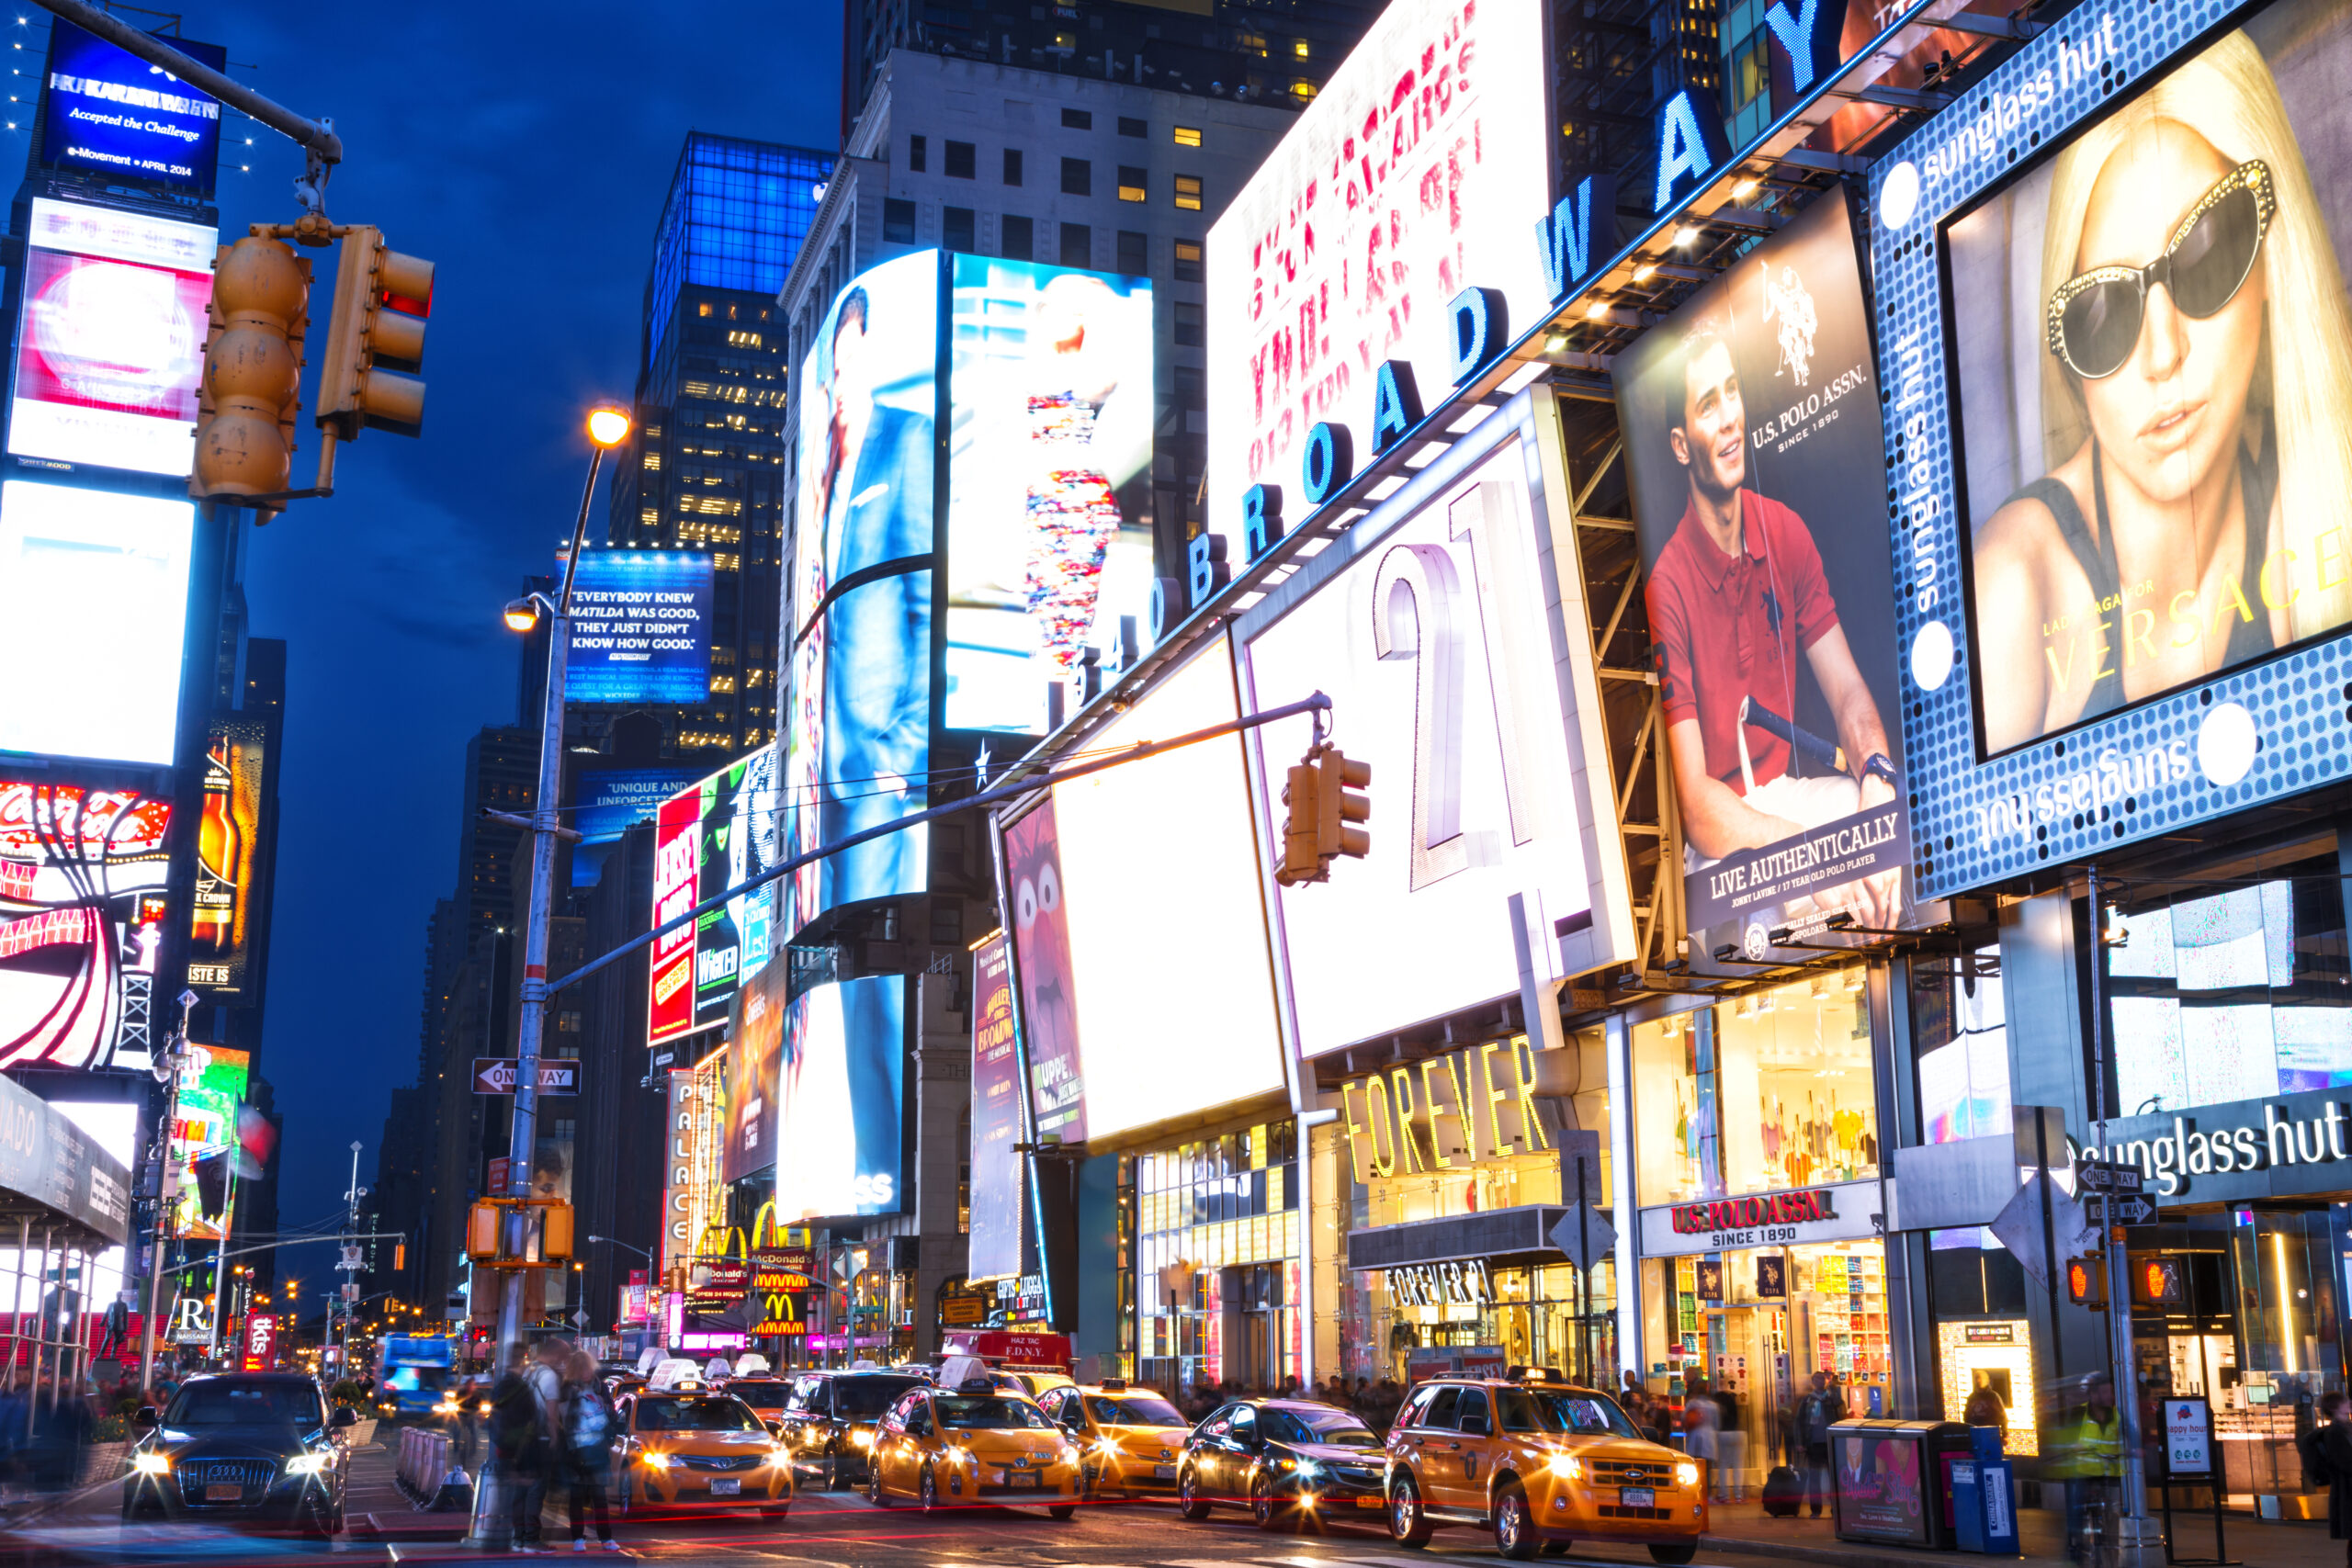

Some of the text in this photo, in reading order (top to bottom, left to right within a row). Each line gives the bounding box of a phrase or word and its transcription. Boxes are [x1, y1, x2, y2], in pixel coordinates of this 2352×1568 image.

[1925, 13, 2119, 186] sunglass hut
[69, 107, 199, 142] Accepted the Challenge
[141, 160, 168, 173] APRIL
[170, 164, 192, 176] 2014
[1752, 365, 1867, 449] U.S. POLO ASSN.
[1778, 410, 1839, 454] SINCE 1890
[1894, 324, 1940, 614] sunglass hut
[655, 592, 695, 604] KNEW
[2045, 525, 2349, 695] VERSACE
[2127, 580, 2154, 605] FOR
[569, 607, 700, 621] MATILDA WAS GOOD,
[575, 622, 609, 633] THEY
[611, 623, 643, 634] JUST
[572, 637, 615, 649] KNOW
[617, 638, 650, 649] HOW
[597, 795, 669, 806] UNFORGETT
[662, 782, 688, 792] AND
[1978, 739, 2191, 852] sunglass hut
[655, 821, 699, 905] JERSEY
[1710, 812, 1898, 899] LIVE AUTHENTICALLY
[1731, 895, 1752, 908] JONNY
[1753, 886, 1776, 901] LAVINE
[1783, 881, 1791, 892] 17
[1791, 874, 1810, 889] YEAR
[1811, 871, 1826, 882] OLD
[1826, 865, 1846, 878] POLO
[1847, 853, 1875, 872] PLAYER
[1806, 909, 1831, 924] SEALED
[698, 945, 739, 986] WICKED
[492, 1070, 516, 1083] ON
[1342, 1034, 1549, 1183] FOREVER
[2265, 1101, 2349, 1165] hut
[673, 1086, 695, 1240] PALACE
[2086, 1170, 2107, 1183] ONE
[1671, 1190, 1827, 1234] U.S. POLO ASSN.
[2124, 1204, 2145, 1216] WAY
[1712, 1227, 1797, 1247] SINCE 1890
[997, 1275, 1044, 1300] GIFTS LUGGA
[1385, 1259, 1495, 1308] FOREVER 21
[178, 1299, 212, 1331] R
[251, 1317, 273, 1354] tkts
[1005, 1347, 1045, 1358] F.D.N.Y.
